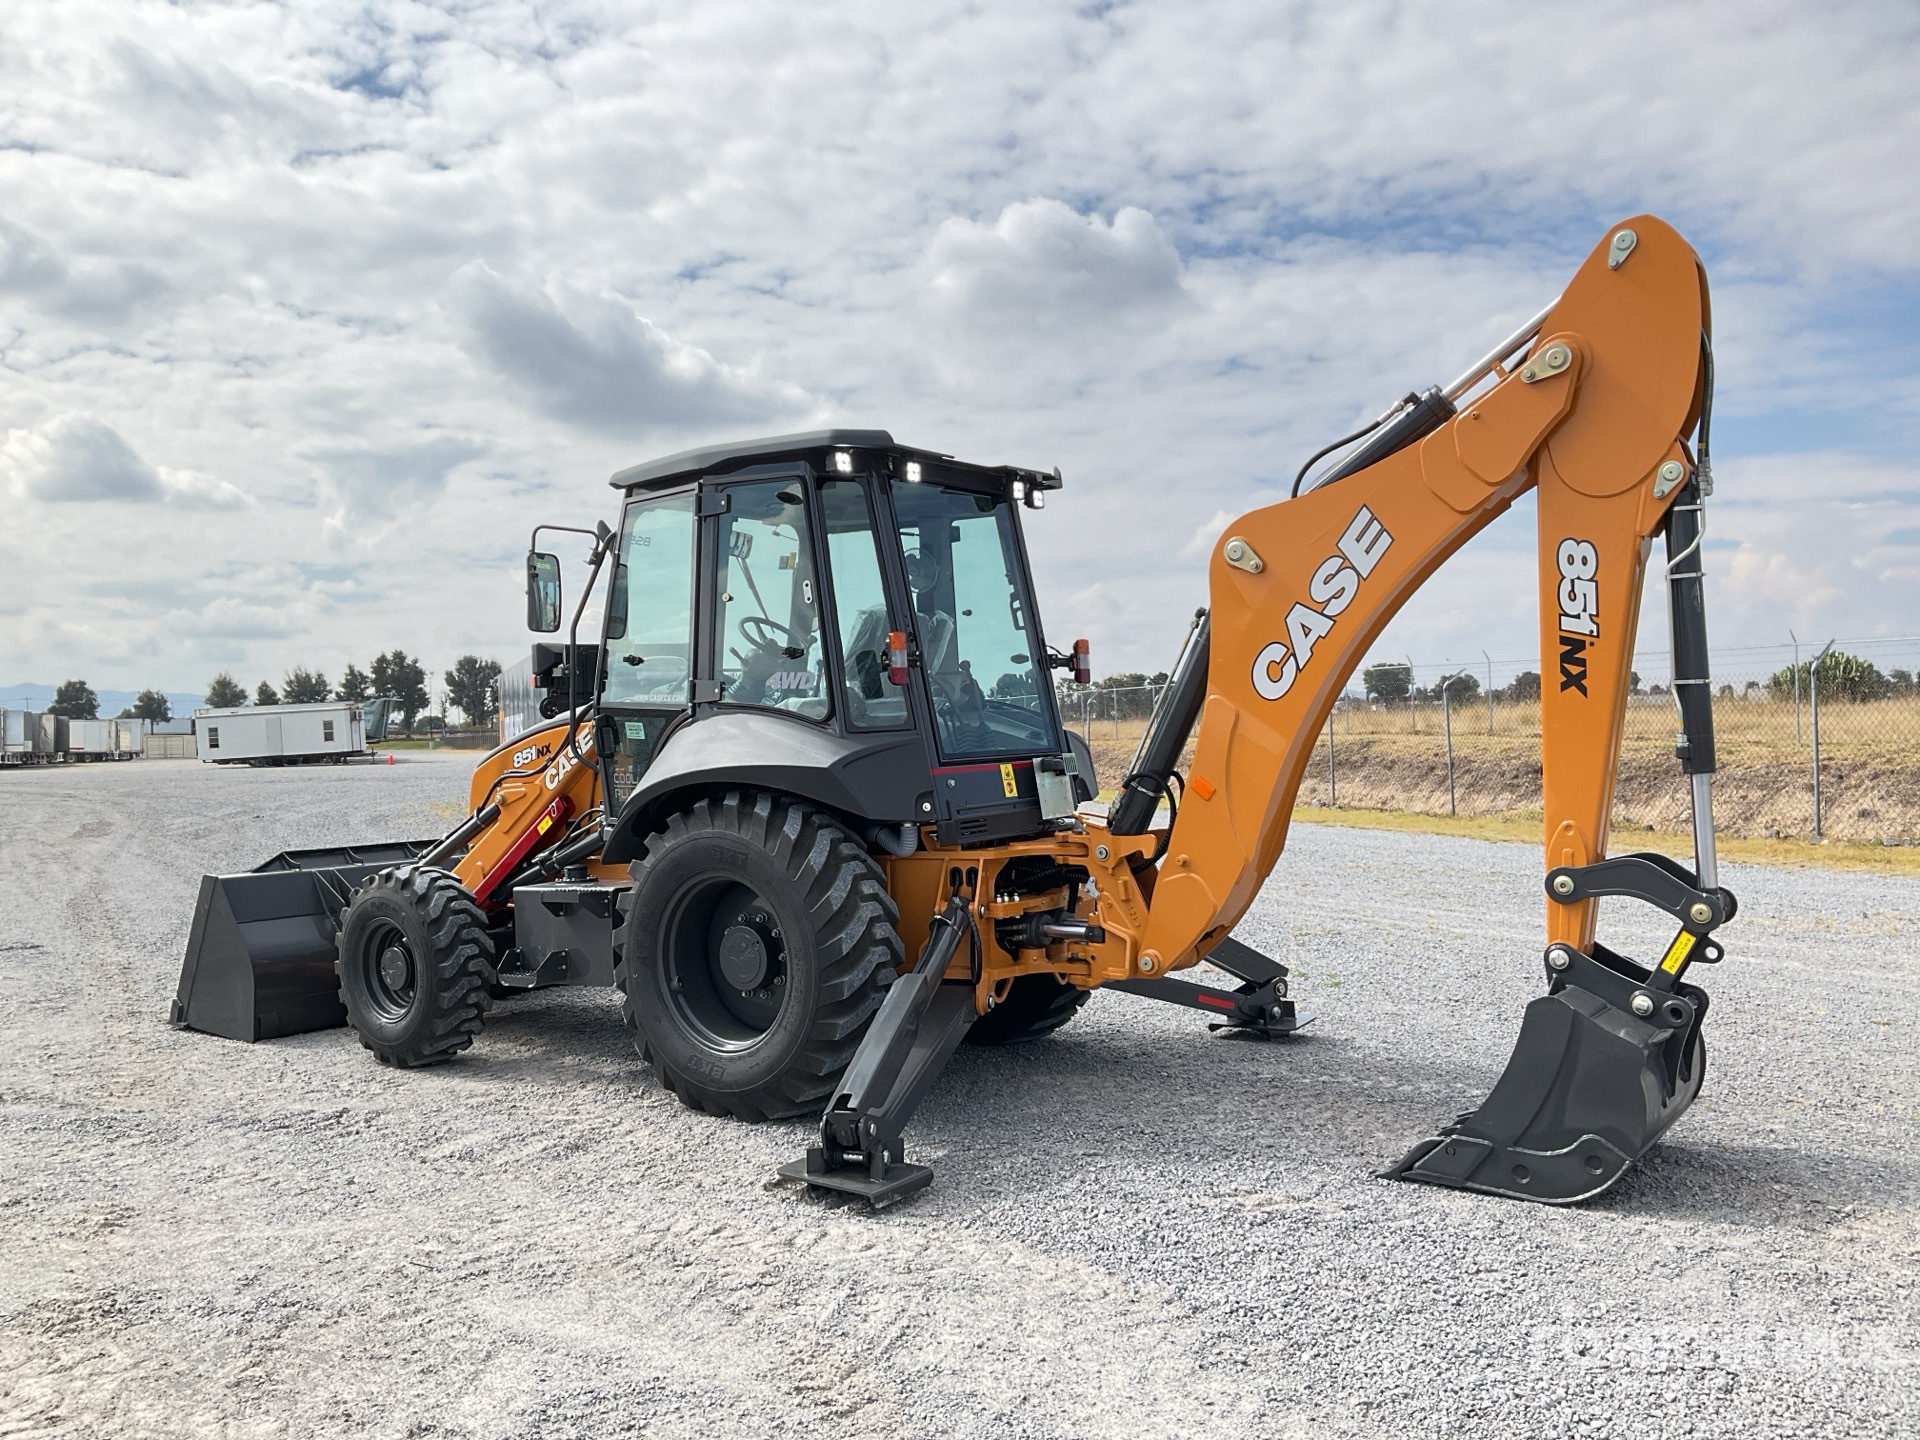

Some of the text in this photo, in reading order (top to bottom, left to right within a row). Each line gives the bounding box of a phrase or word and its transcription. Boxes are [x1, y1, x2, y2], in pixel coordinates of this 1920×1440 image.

[1251, 503, 1395, 701] CASE
[766, 671, 815, 689] 4WD
[545, 727, 594, 791] CASE
